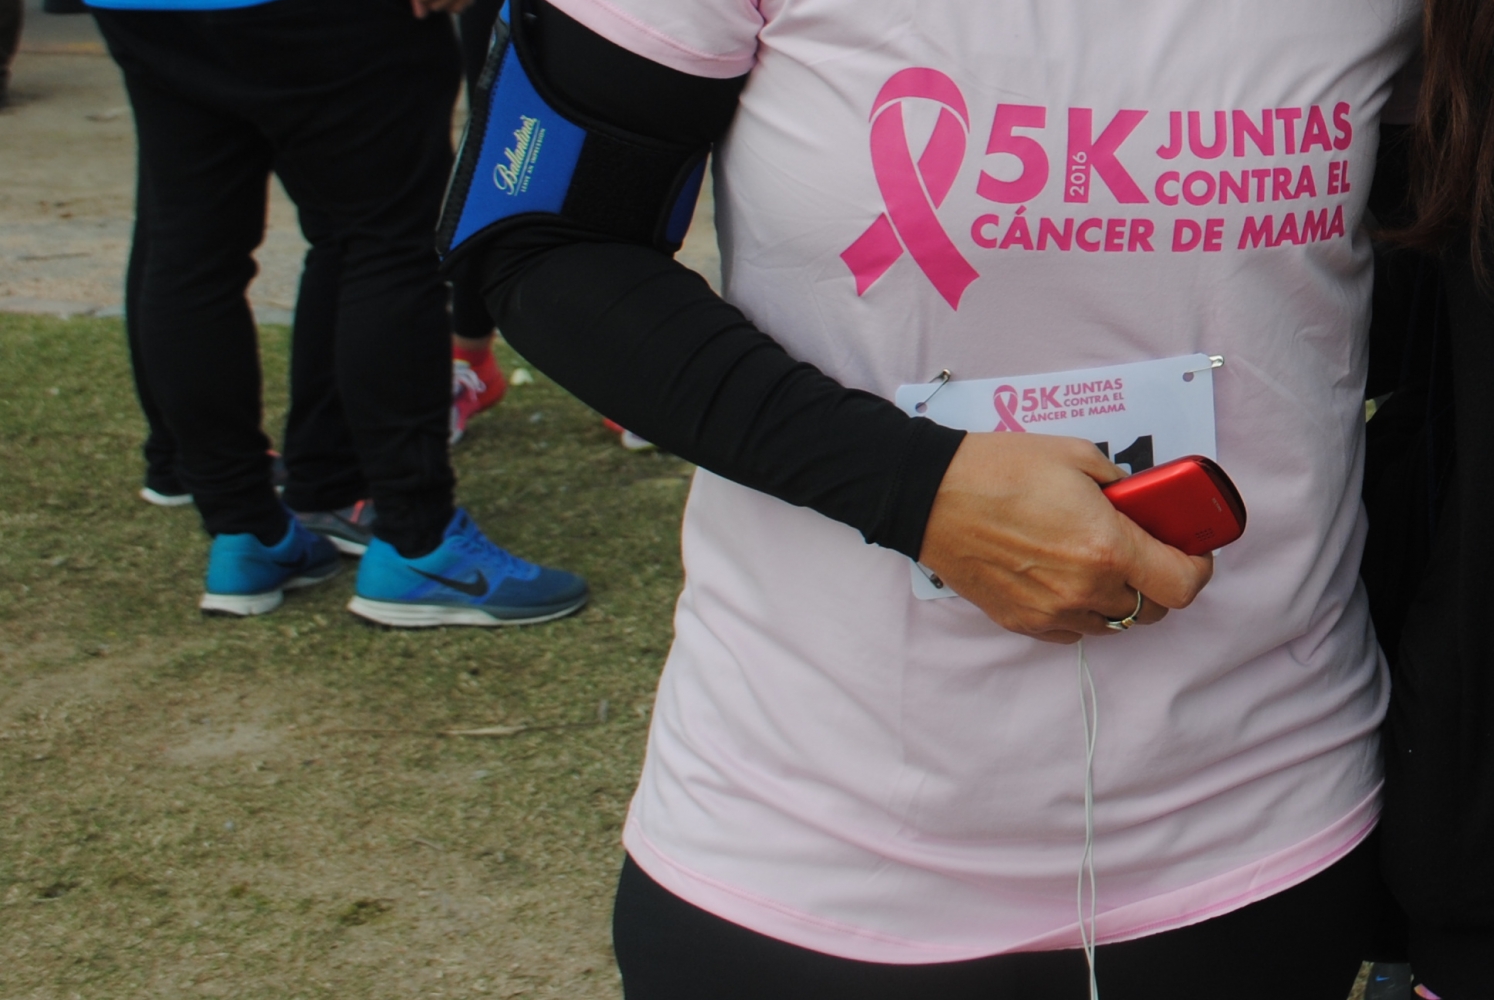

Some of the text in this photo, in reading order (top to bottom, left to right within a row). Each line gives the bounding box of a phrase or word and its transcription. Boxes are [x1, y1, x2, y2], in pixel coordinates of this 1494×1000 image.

[1156, 101, 1353, 159] JUNTAS
[976, 103, 1150, 204] 5K
[1070, 151, 1087, 196] 2016
[1154, 160, 1351, 206] CONTRA EL
[970, 205, 1345, 252] CÁNCER DE MAMA
[1021, 385, 1063, 412] 5K
[1063, 378, 1123, 396] JUNTAS
[1063, 392, 1124, 407] CONTRA EL
[1022, 403, 1126, 423] CÁNCER DE MAMA
